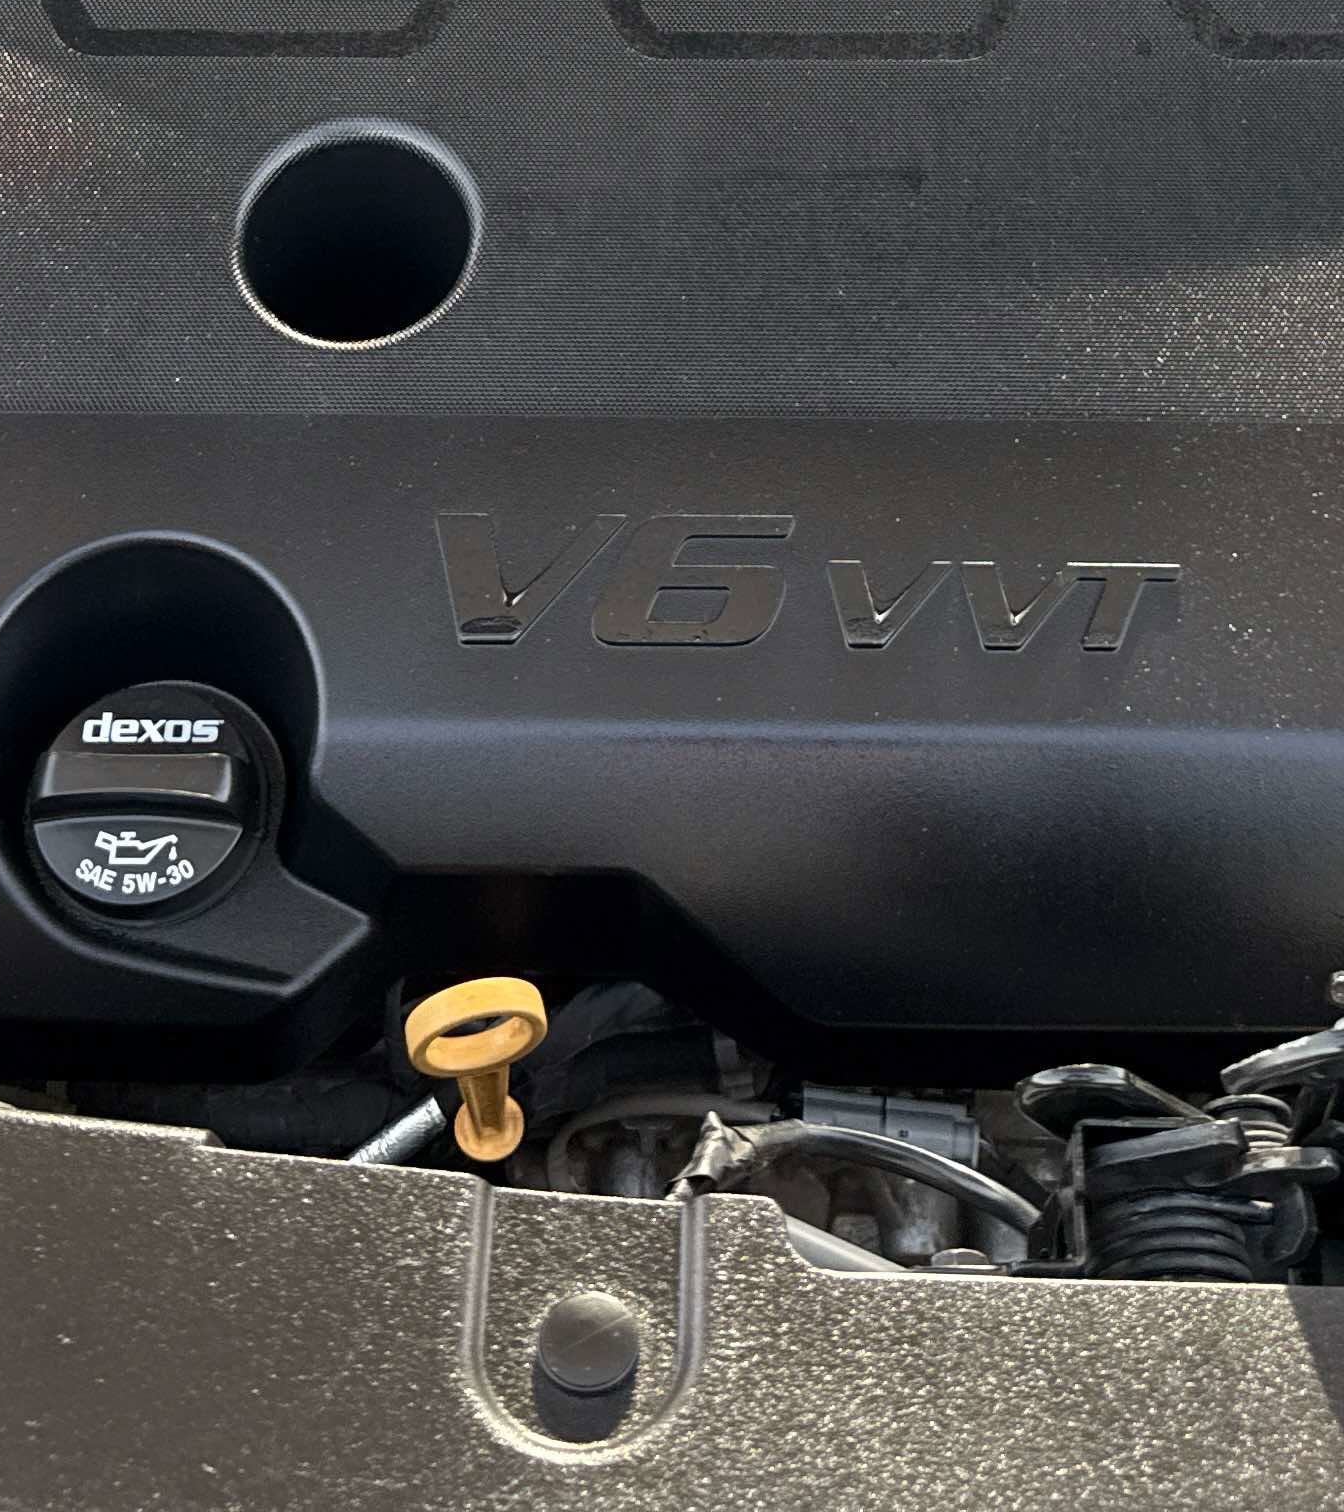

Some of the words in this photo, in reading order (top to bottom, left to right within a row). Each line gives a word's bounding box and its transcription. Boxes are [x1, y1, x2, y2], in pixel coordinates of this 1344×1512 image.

[434, 513, 795, 648] V6
[826, 559, 1182, 652] VVT
[82, 712, 220, 743] dexos
[75, 859, 117, 892] SAE
[121, 859, 194, 893] 5W-30
